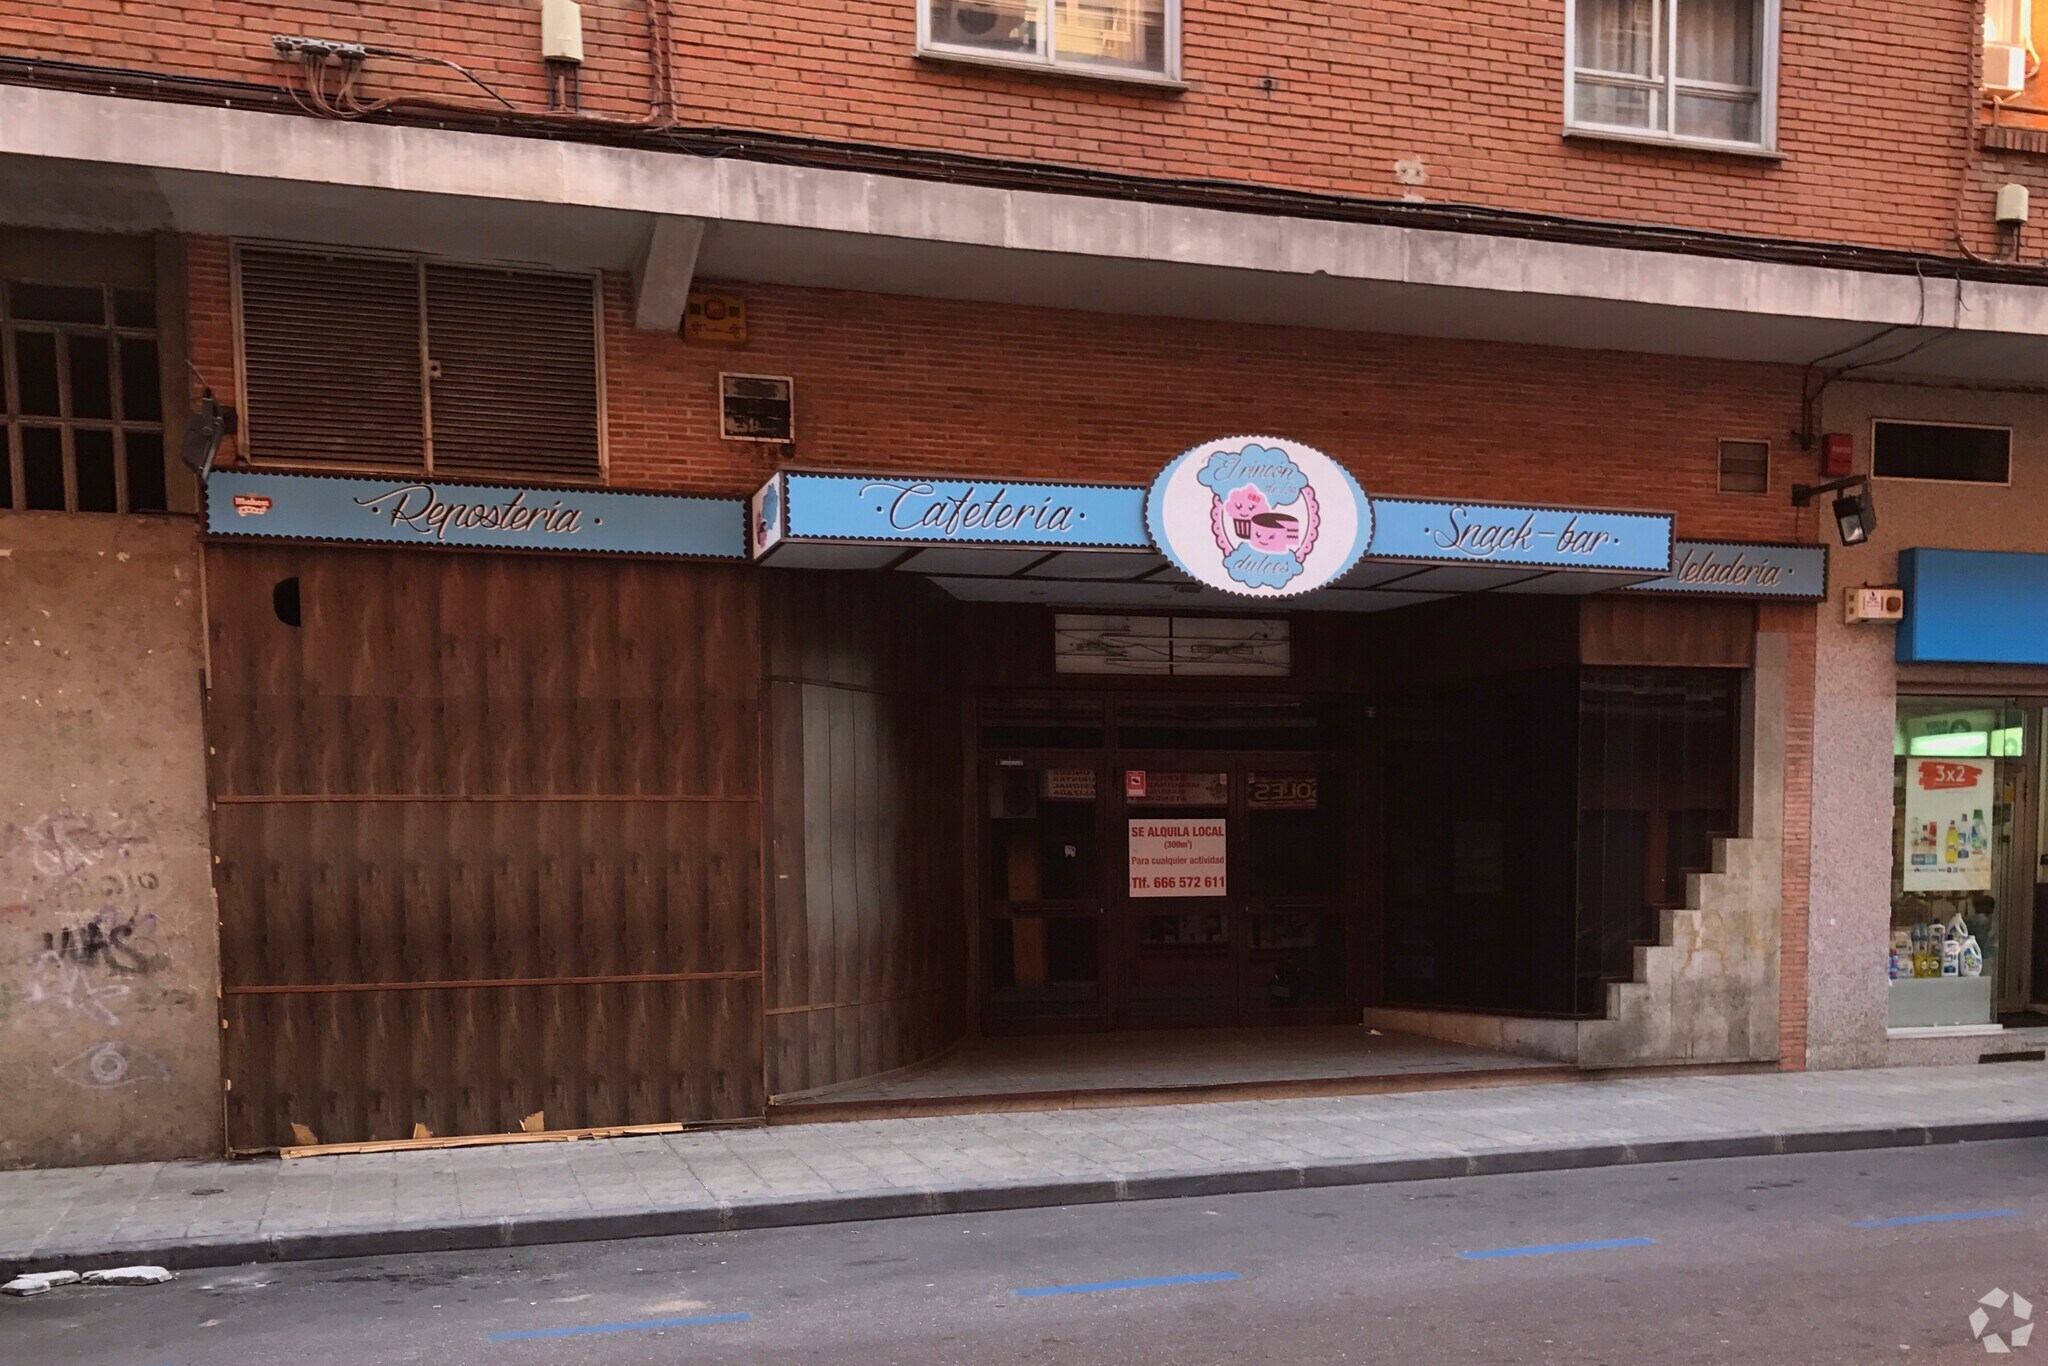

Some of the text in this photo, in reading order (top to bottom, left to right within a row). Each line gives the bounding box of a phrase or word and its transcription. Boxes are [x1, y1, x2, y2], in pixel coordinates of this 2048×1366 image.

[1201, 455, 1294, 481] El rincón
[353, 484, 582, 541] Repostería
[859, 483, 1073, 536] Cafetería
[1233, 554, 1290, 574] dulces
[1935, 765, 1966, 783] 3x2
[1131, 826, 1224, 838] SE ALQUILA LOCAL
[1131, 855, 1224, 867] Para cualquier actividad
[1131, 876, 1225, 889] Tlf. 666 572 611
